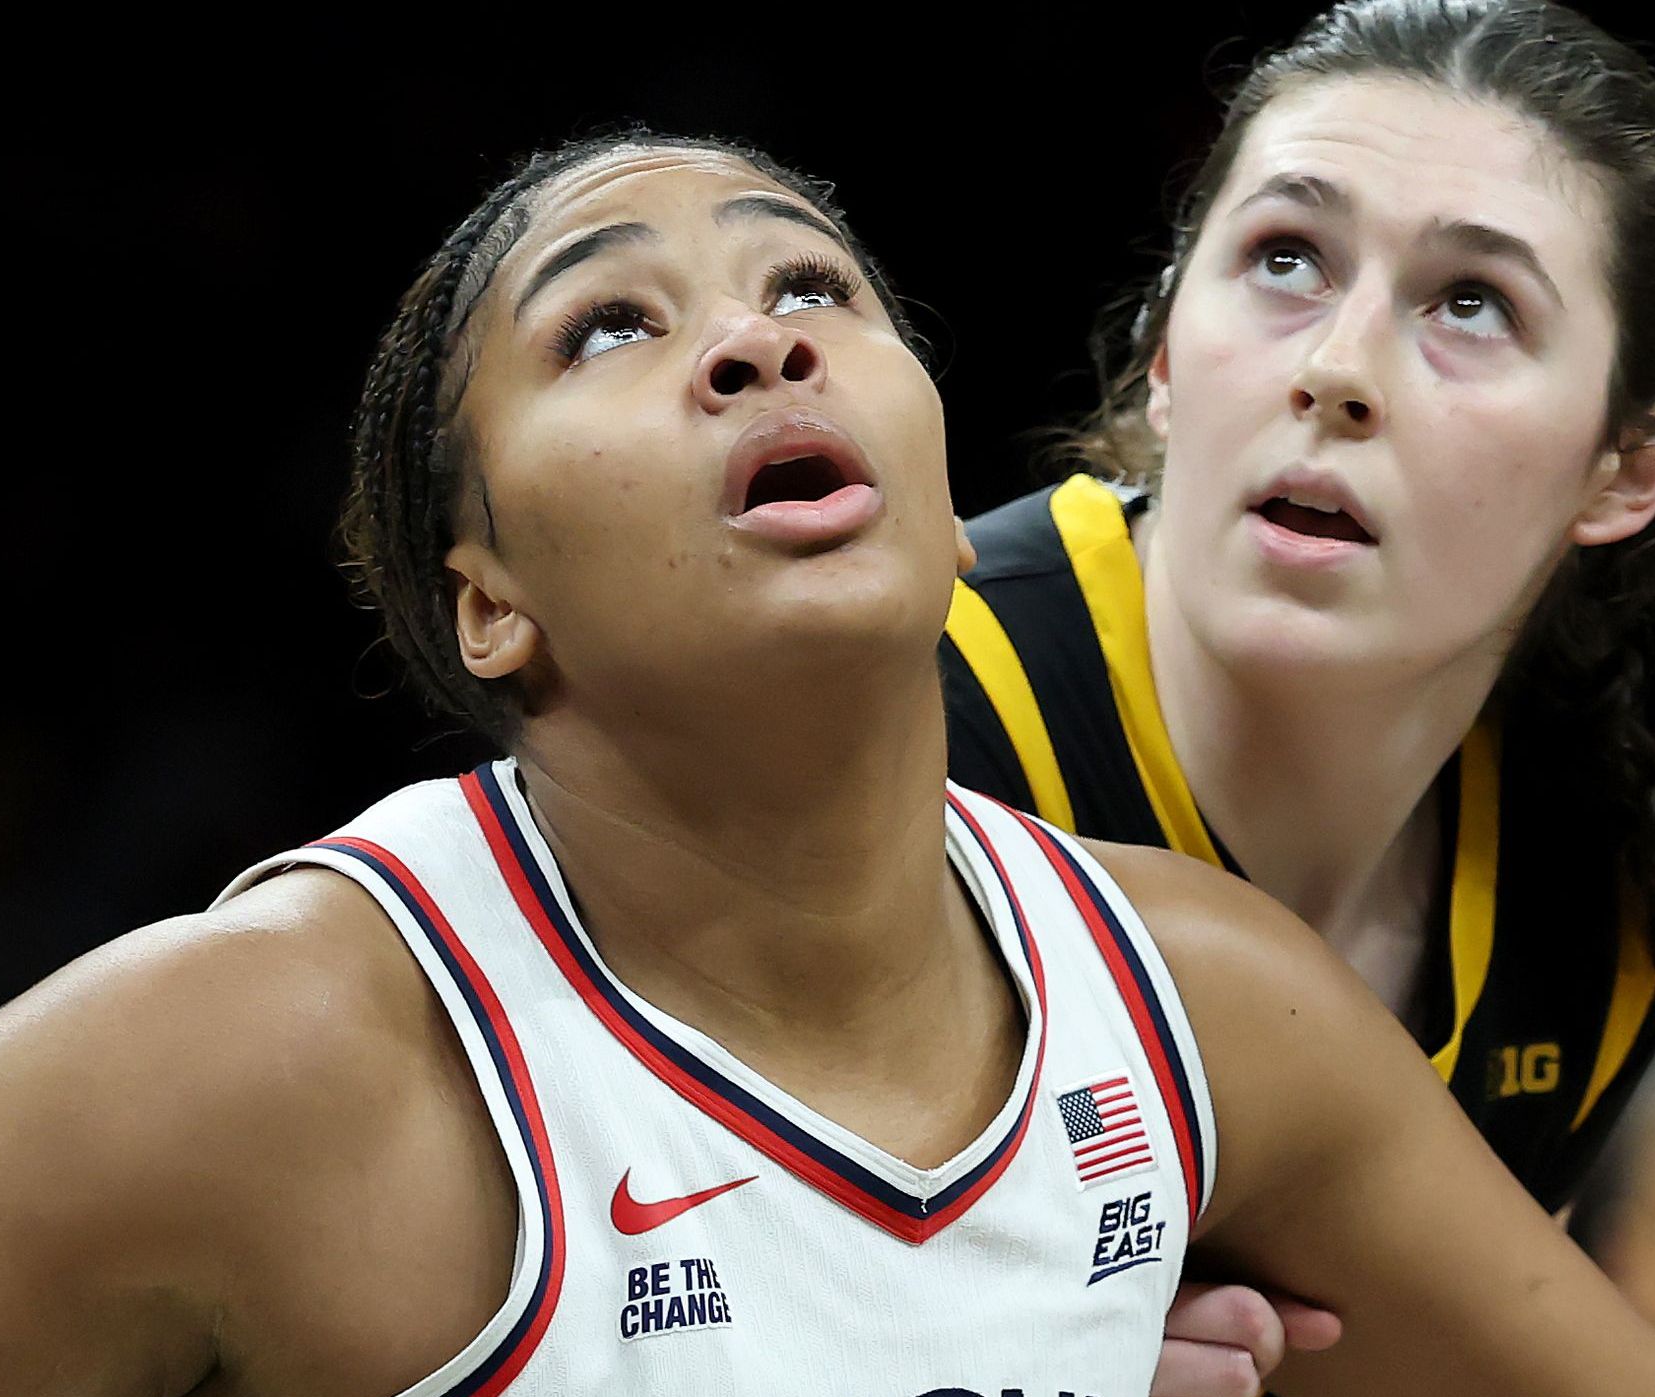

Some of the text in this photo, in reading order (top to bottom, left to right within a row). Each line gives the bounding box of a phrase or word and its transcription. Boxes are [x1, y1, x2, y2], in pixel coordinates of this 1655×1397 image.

[1099, 1191, 1152, 1234] BIG
[1092, 1221, 1166, 1267] EAST
[628, 1258, 721, 1302] BE THE
[620, 1291, 732, 1339] CHANGE
